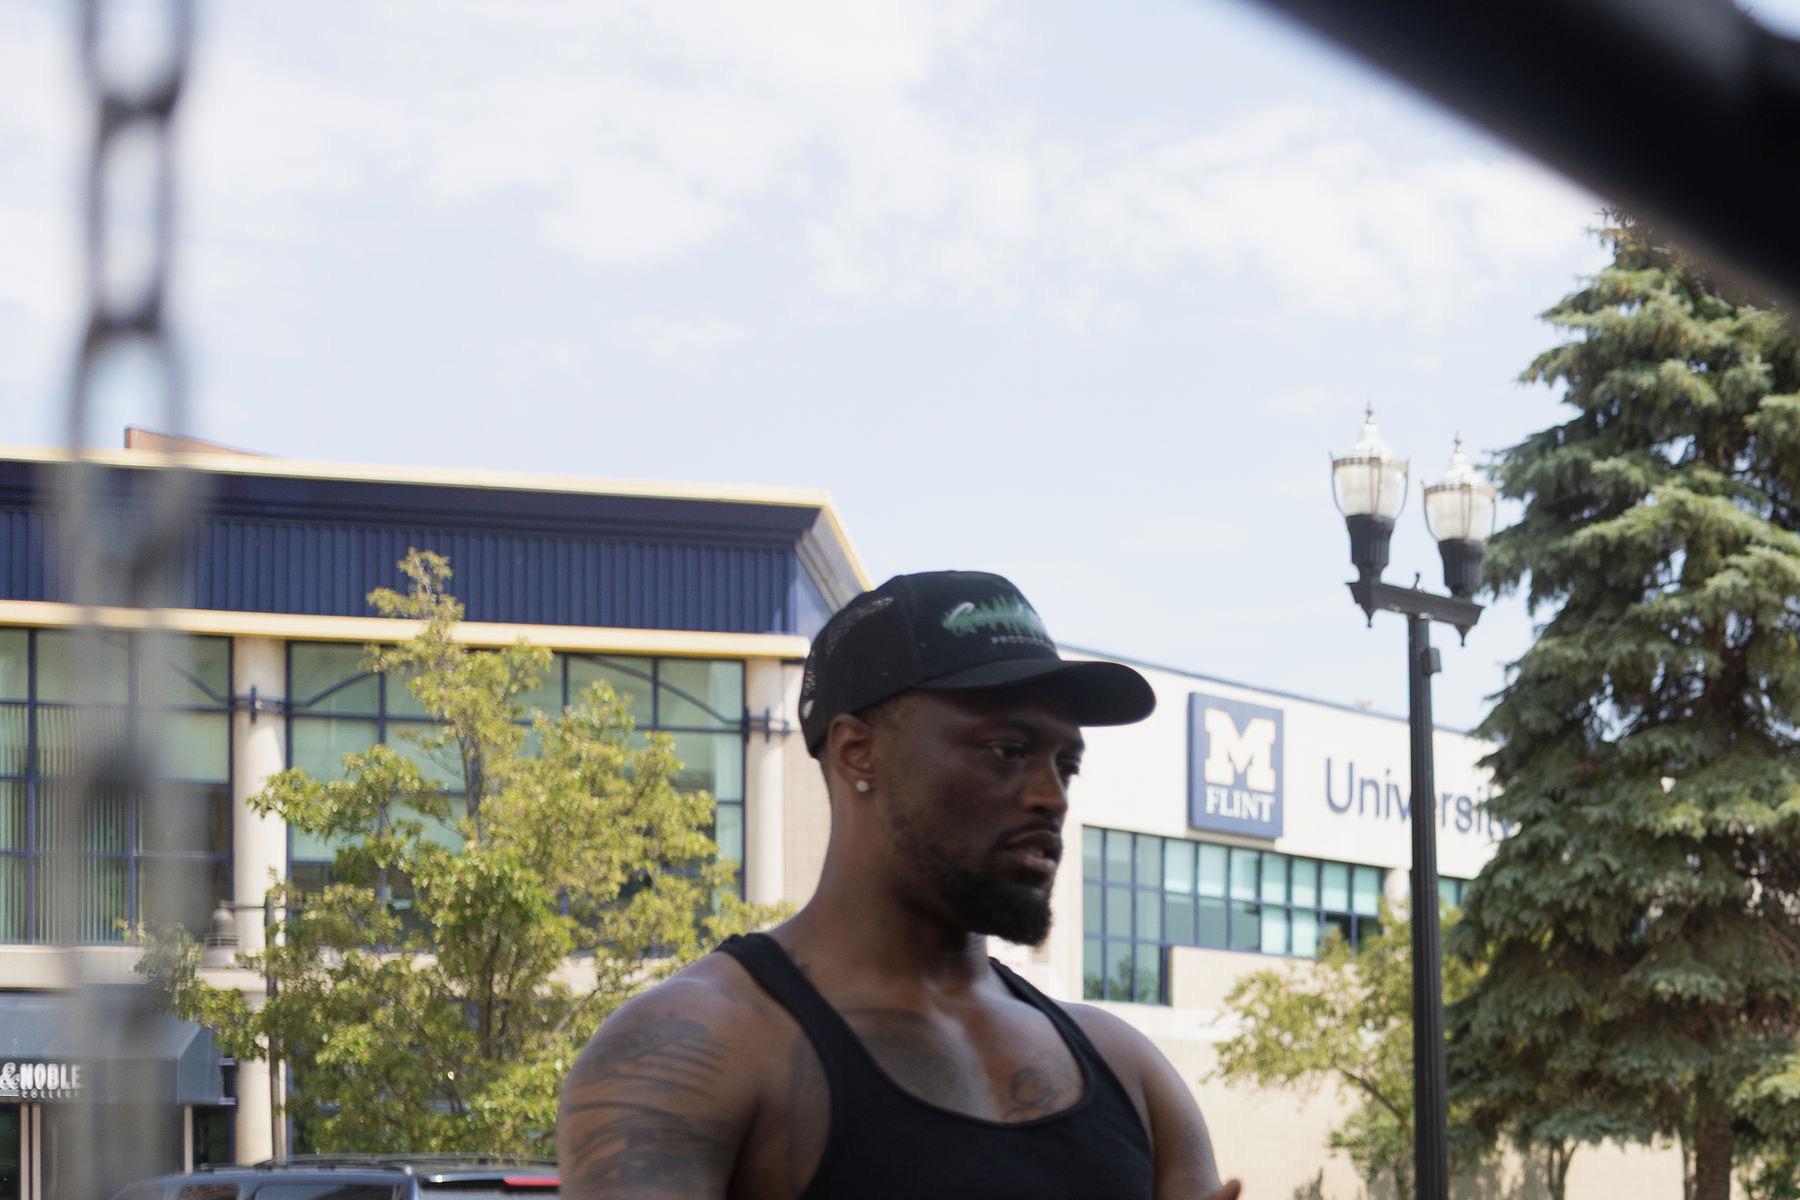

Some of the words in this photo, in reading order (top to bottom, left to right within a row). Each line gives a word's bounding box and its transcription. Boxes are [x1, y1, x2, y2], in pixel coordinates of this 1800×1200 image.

[1204, 708, 1276, 793] M
[1204, 784, 1275, 824] FLINT
[1325, 756, 1514, 841] Univrsit
